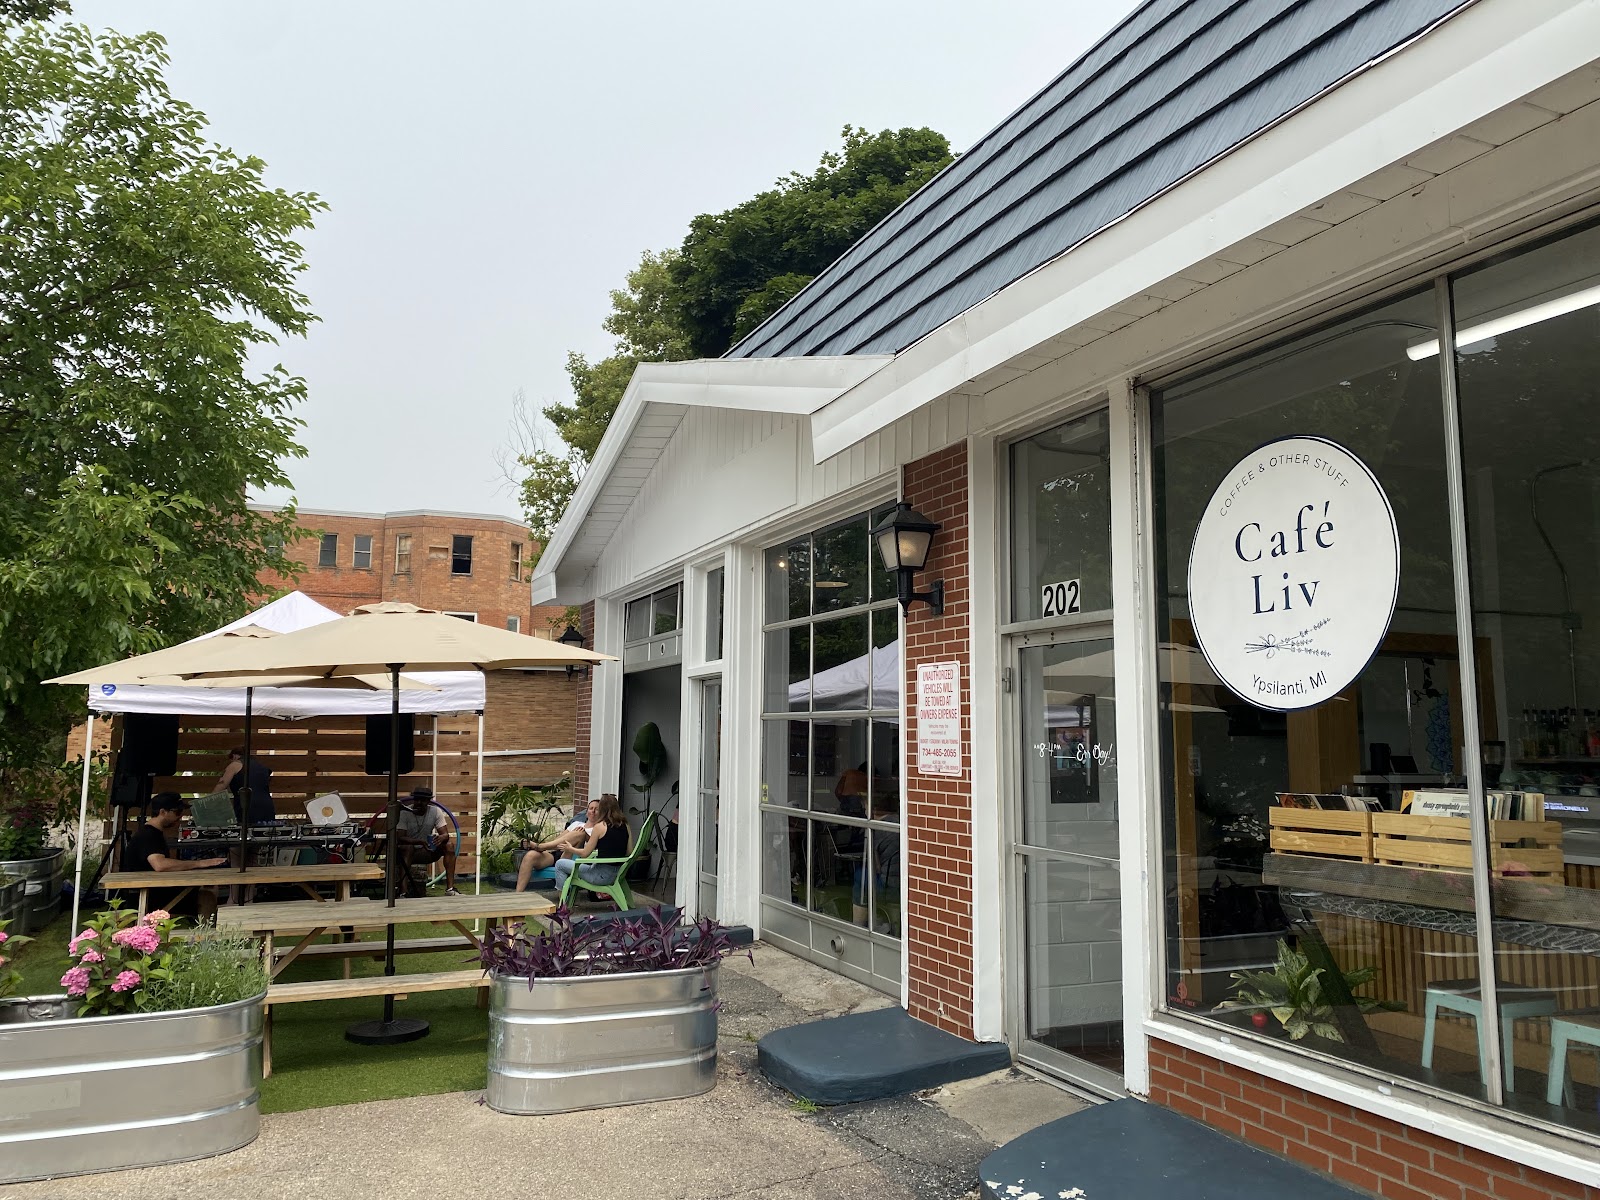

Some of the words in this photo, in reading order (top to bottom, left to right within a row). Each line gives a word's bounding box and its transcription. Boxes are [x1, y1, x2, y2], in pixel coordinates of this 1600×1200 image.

[1220, 470, 1255, 517] COFFEE
[1258, 463, 1265, 473] &
[1269, 453, 1310, 468] OTHER
[1313, 458, 1349, 488] STUFF
[1235, 500, 1335, 563] Café
[1043, 580, 1080, 618] 202
[1250, 572, 1320, 615] Liv
[923, 669, 953, 681] UNAUTHORIZED
[923, 683, 942, 694] VEHICLES
[943, 682, 953, 692] WILL
[1252, 674, 1308, 696] Ypsilanti,
[1309, 670, 1327, 689] MI
[920, 709, 937, 719] OWNERS
[938, 708, 957, 719] EXPENSE
[925, 696, 930, 706] BE
[931, 696, 945, 706] TOWED
[946, 695, 951, 705] AT
